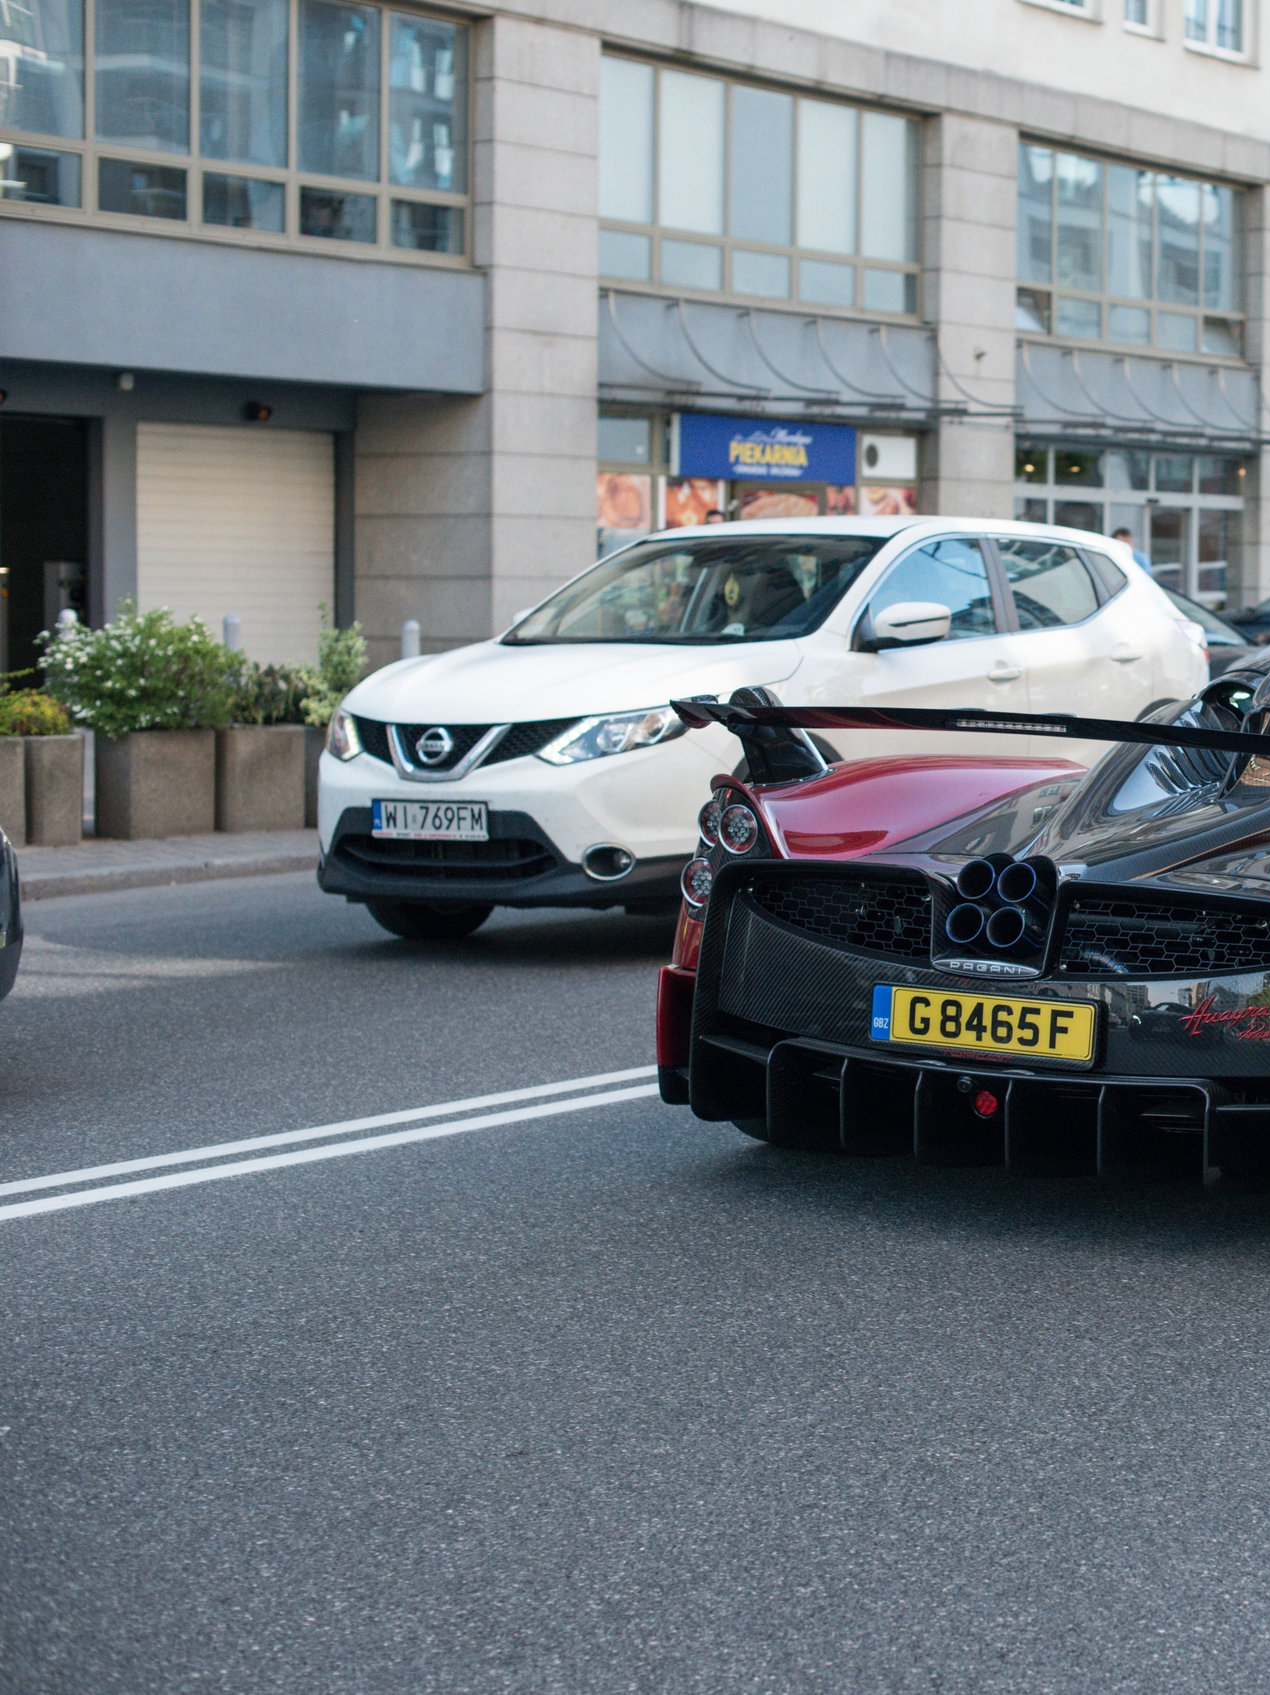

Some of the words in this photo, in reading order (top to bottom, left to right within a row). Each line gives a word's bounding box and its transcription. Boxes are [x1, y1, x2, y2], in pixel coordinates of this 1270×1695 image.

[729, 440, 808, 467] PIEKARNIA
[384, 804, 408, 829] WI
[419, 806, 483, 831] 769FM
[949, 961, 1022, 975] PAGANI
[873, 1016, 889, 1029] GBZ
